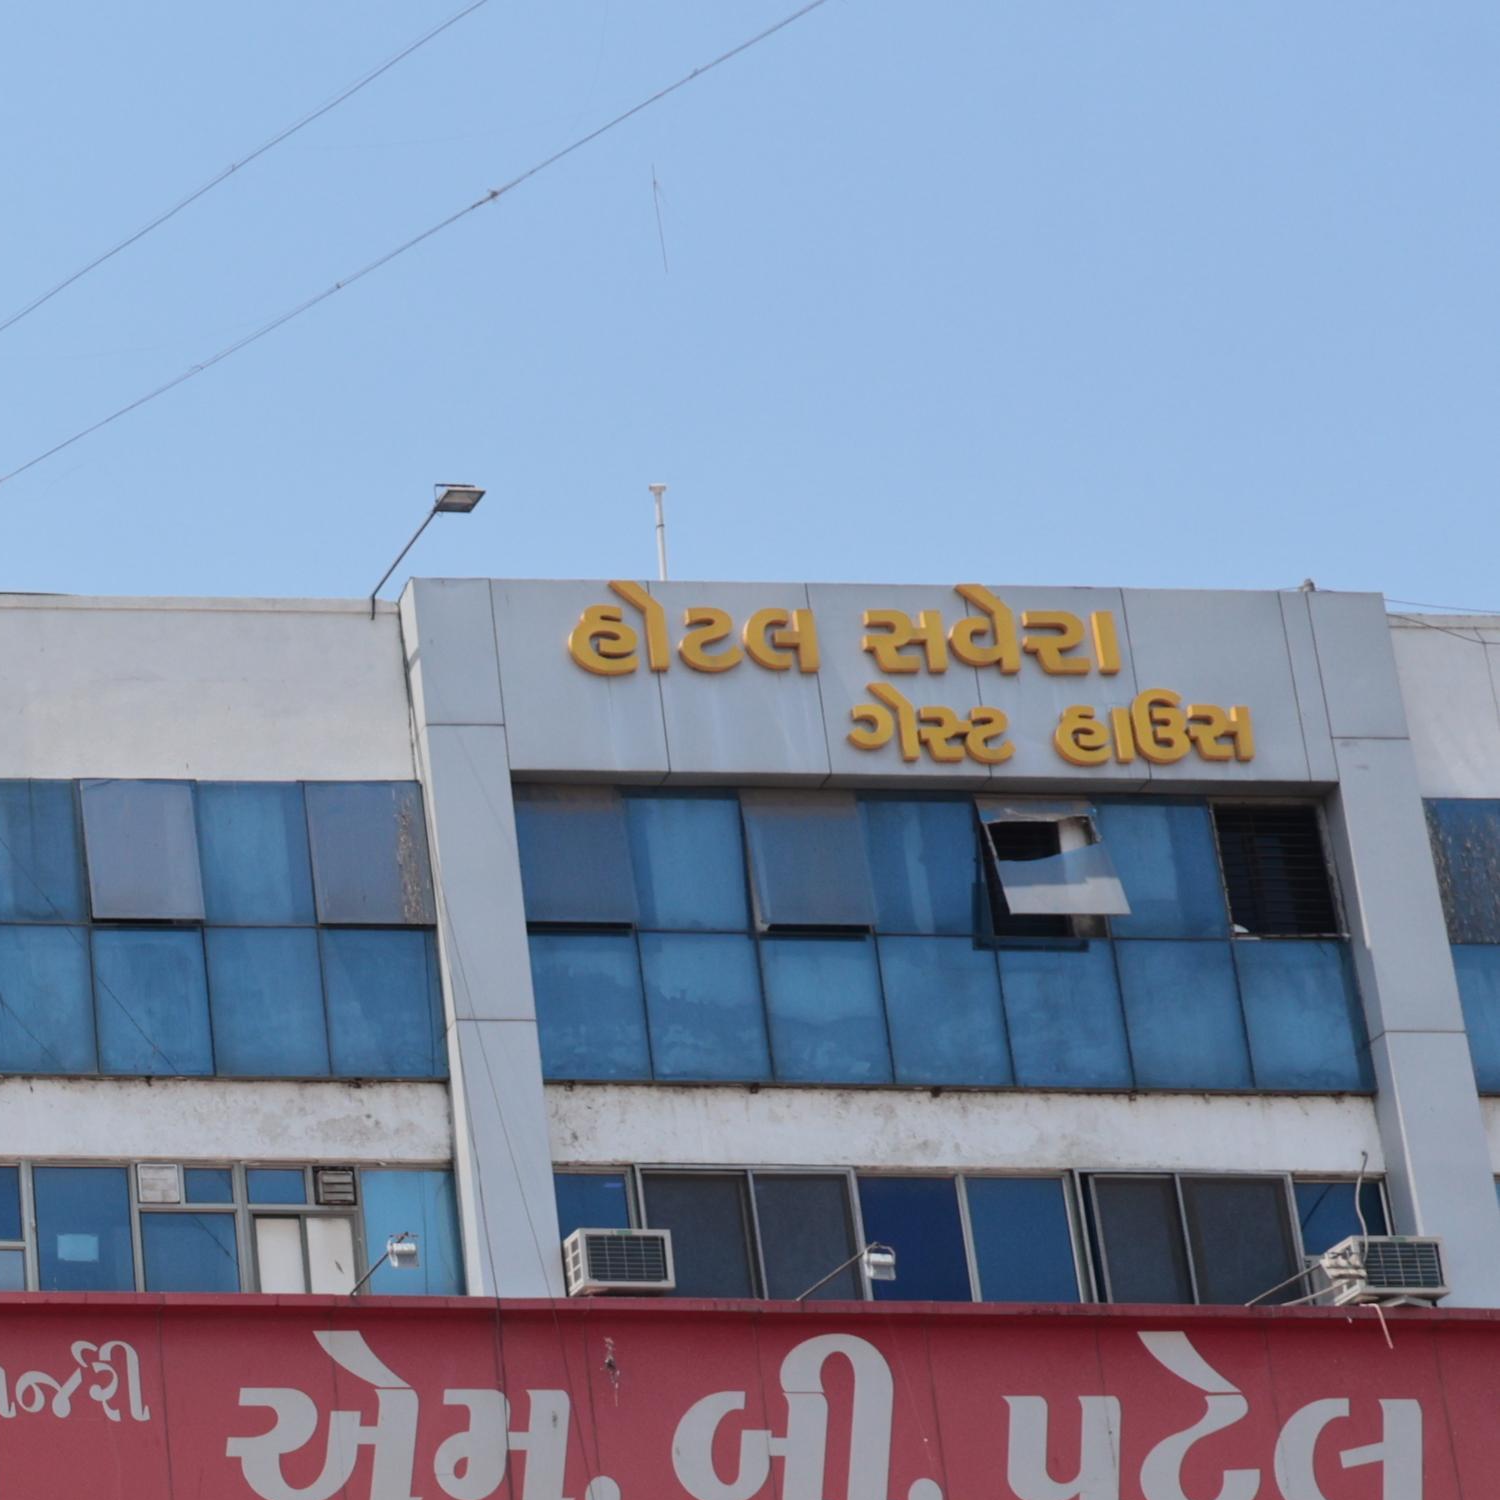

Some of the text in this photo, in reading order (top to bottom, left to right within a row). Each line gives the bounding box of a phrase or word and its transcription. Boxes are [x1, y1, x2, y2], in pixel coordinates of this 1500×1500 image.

[568, 579, 1122, 676] હોટલ સવેરા
[847, 681, 1256, 767] ગેસ્ટ હાઉસ
